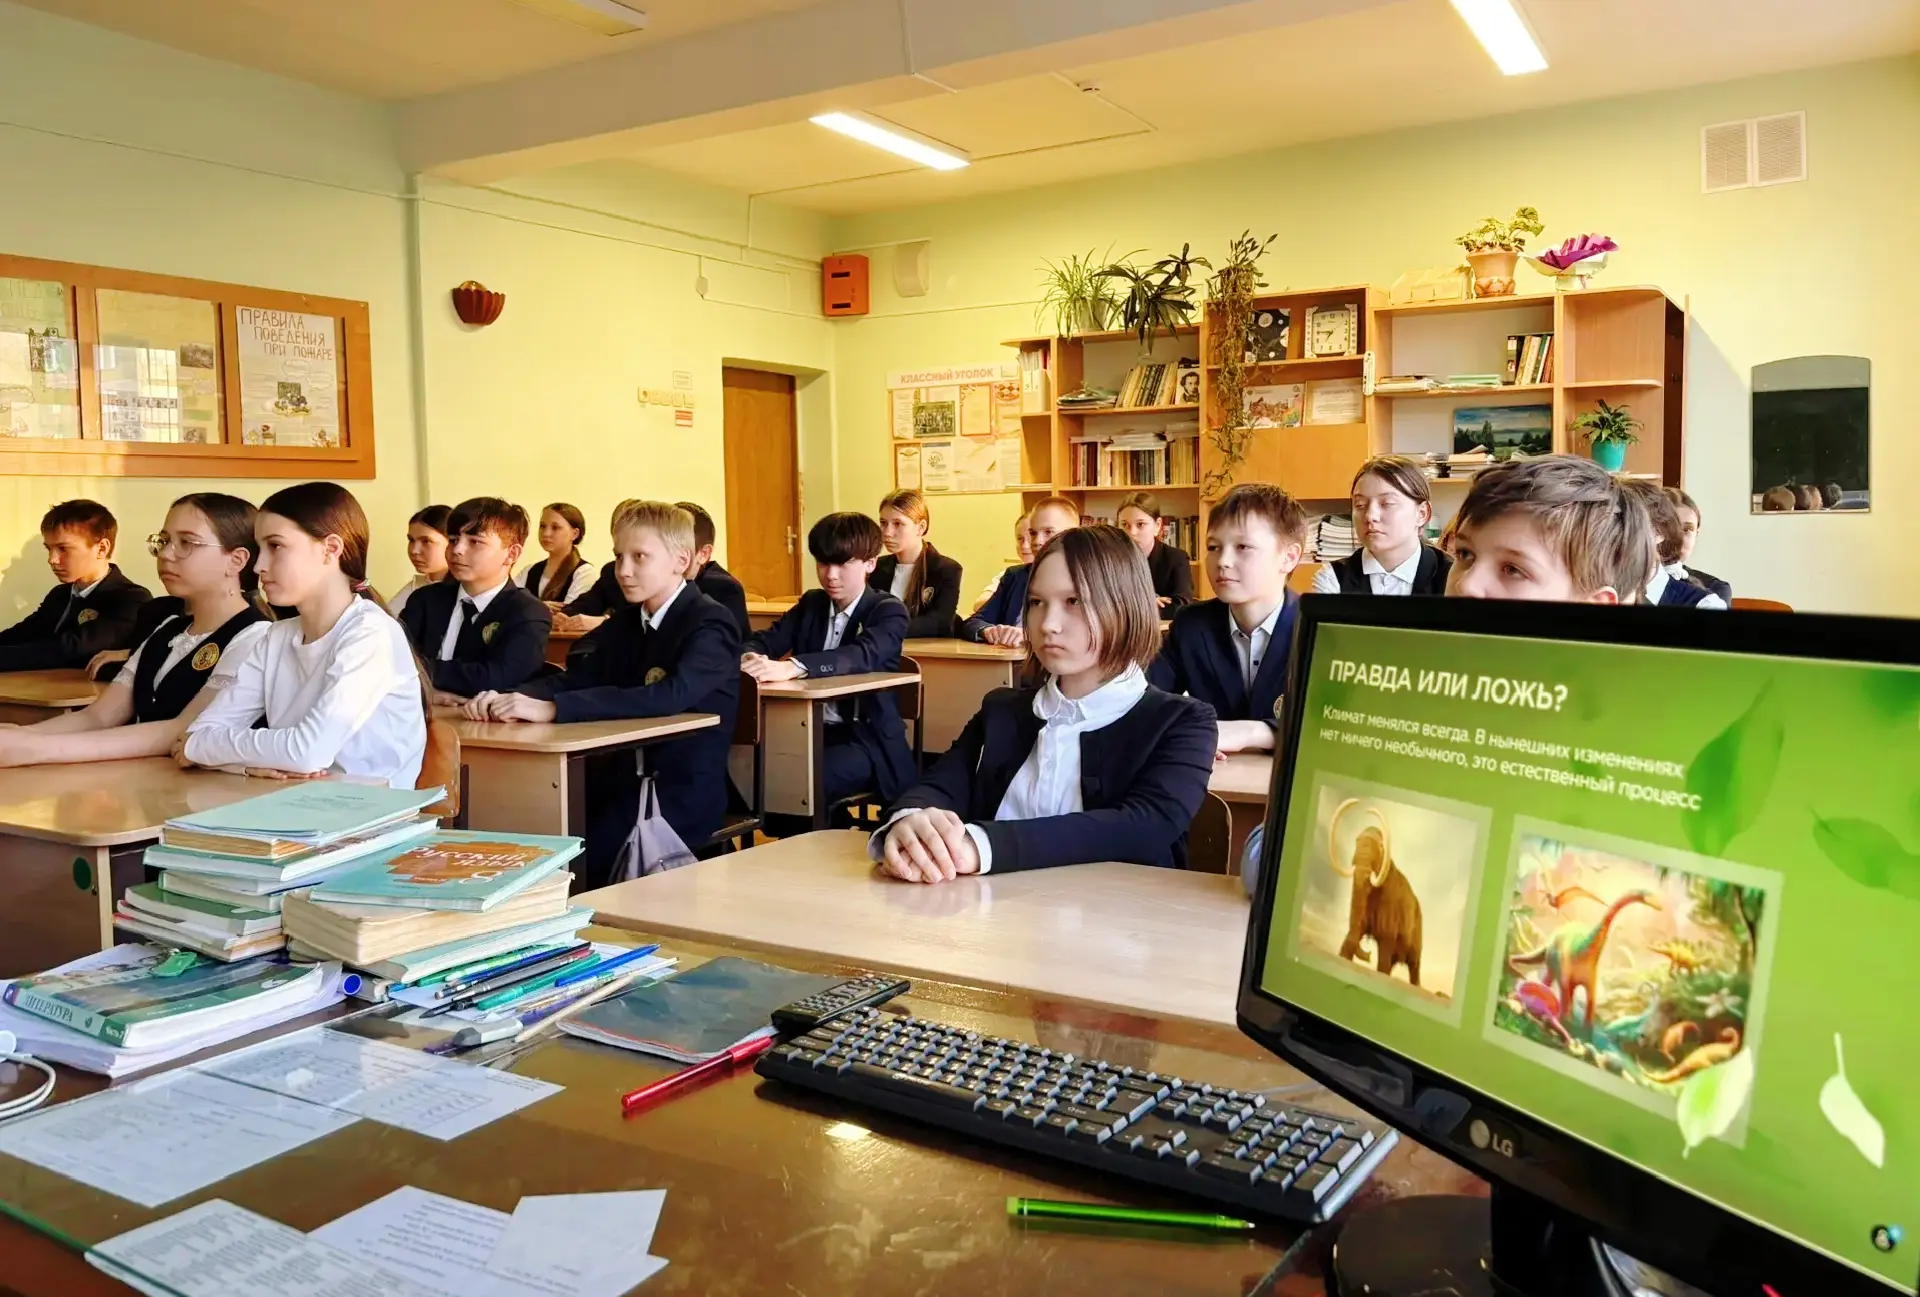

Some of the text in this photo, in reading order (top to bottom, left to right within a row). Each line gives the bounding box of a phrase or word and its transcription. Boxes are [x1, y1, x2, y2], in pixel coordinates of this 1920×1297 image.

[240, 307, 305, 330] ПРАВИЛА
[254, 326, 325, 347] ПОВЕДЕНИЯ
[264, 342, 333, 361] ПРИ ПОЖАРЕ
[900, 368, 995, 384] КЛАССНЫЙ УГОЛОК
[1329, 660, 1568, 712] ПРАВДА ИЛИ ЛОЖЬ?
[1322, 704, 1685, 780] Климат менялся всегда. В нынешних изменениях
[1319, 728, 1703, 811] нет ничего необычного, это естественный процесс
[458, 870, 504, 884] 8
[1492, 1133, 1513, 1158] LG
